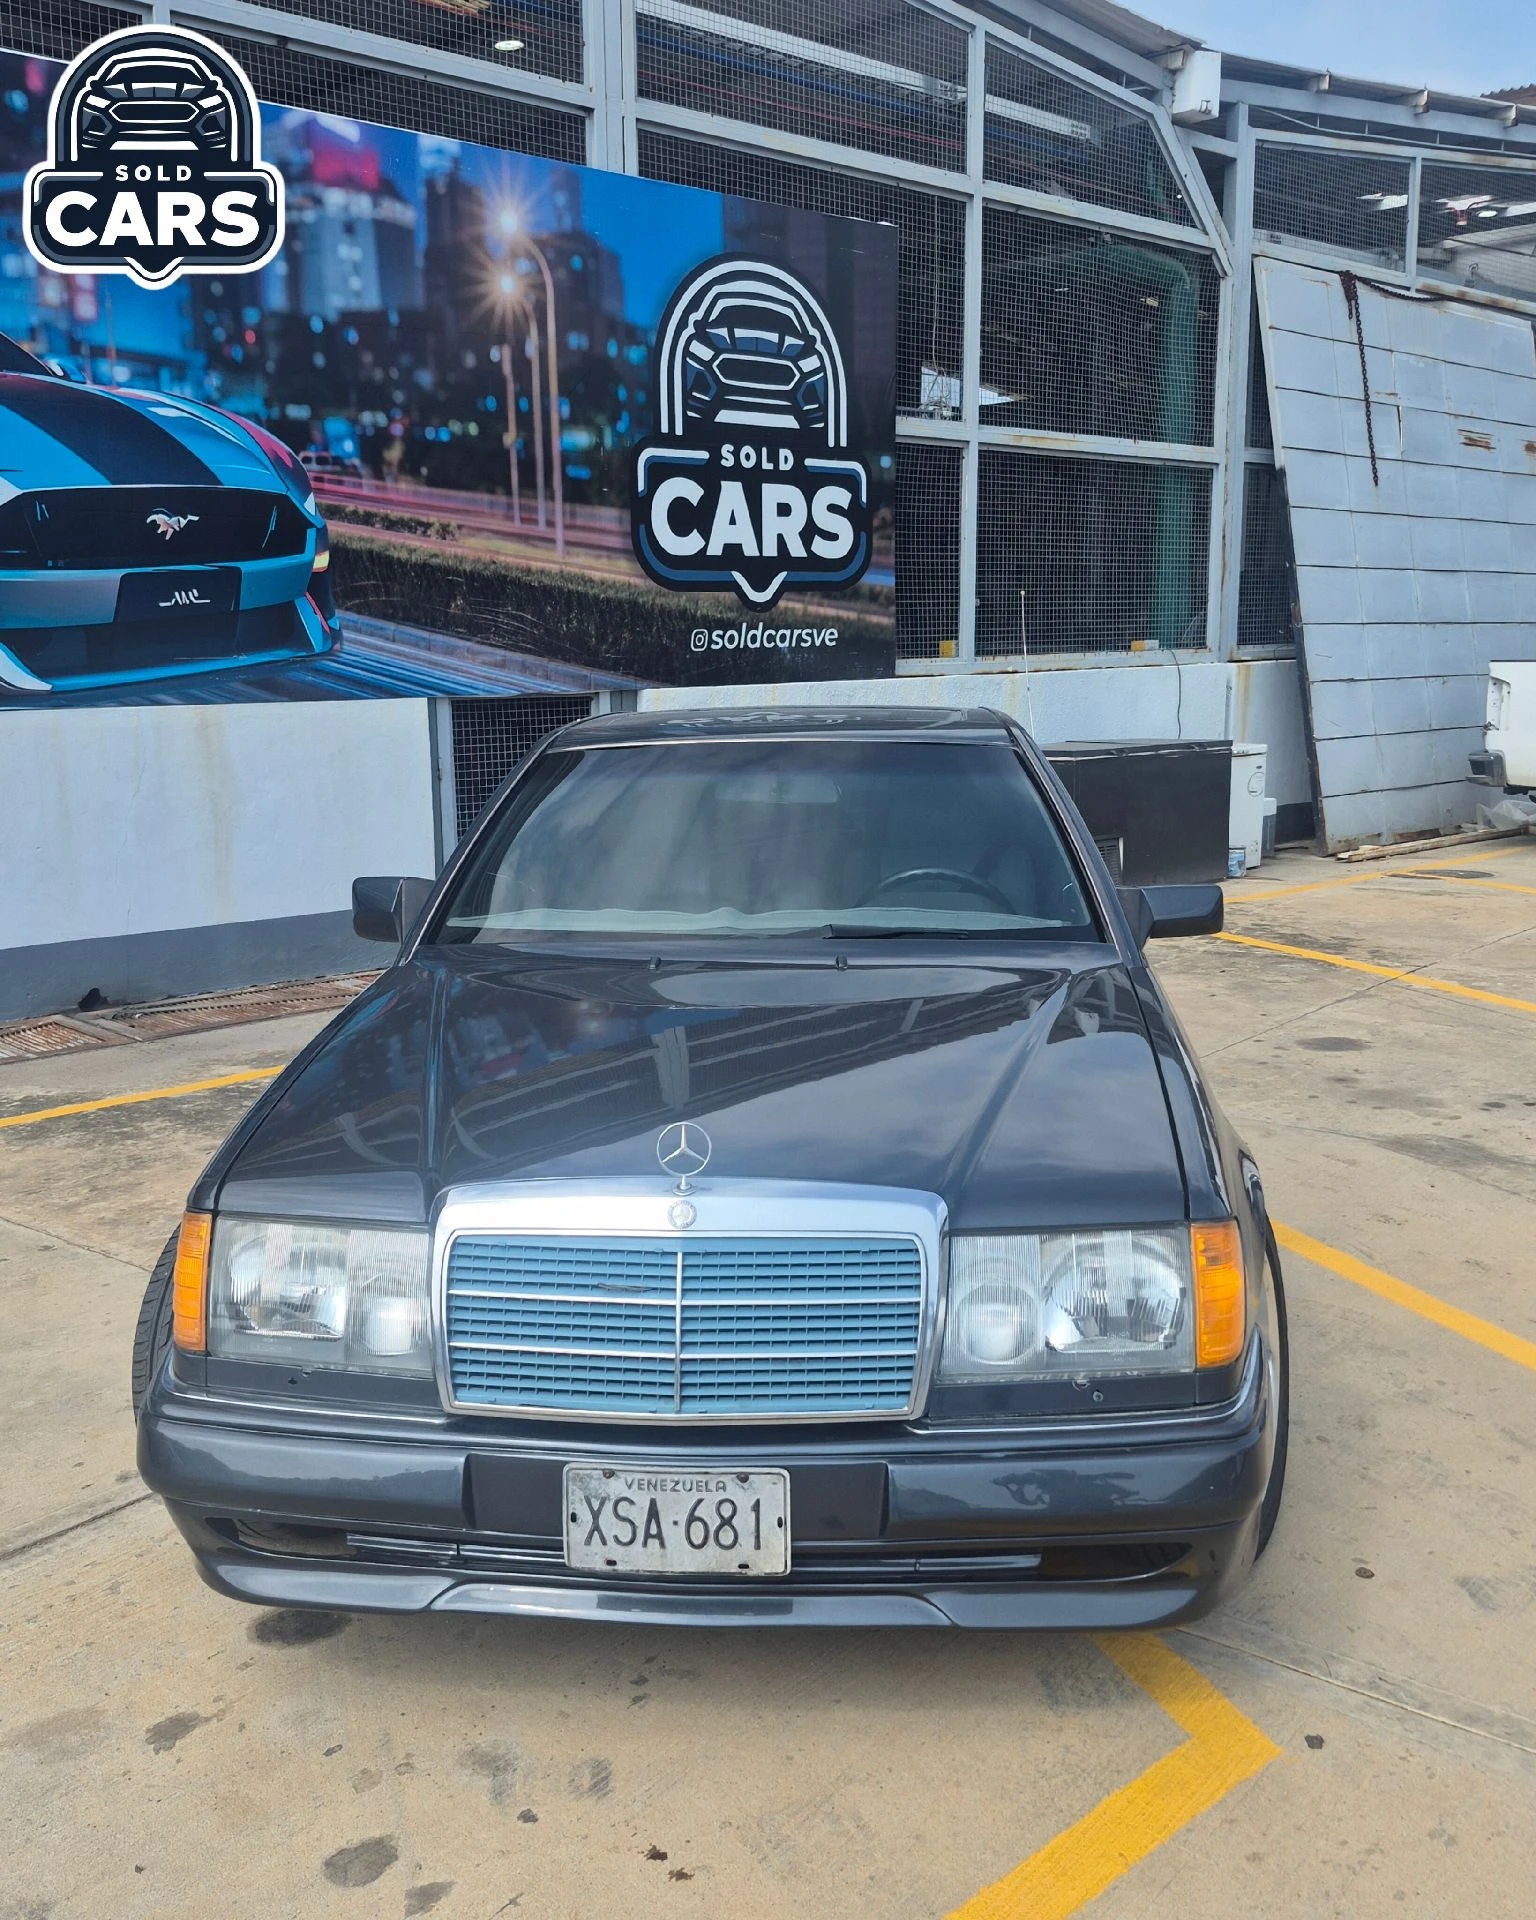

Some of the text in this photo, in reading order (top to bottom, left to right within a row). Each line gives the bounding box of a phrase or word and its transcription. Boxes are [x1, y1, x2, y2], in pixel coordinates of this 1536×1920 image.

[720, 443, 794, 471] SOLD
[651, 476, 854, 559] CARS
[710, 622, 839, 650] soldcarsve
[624, 1478, 727, 1493] VENEZUELA
